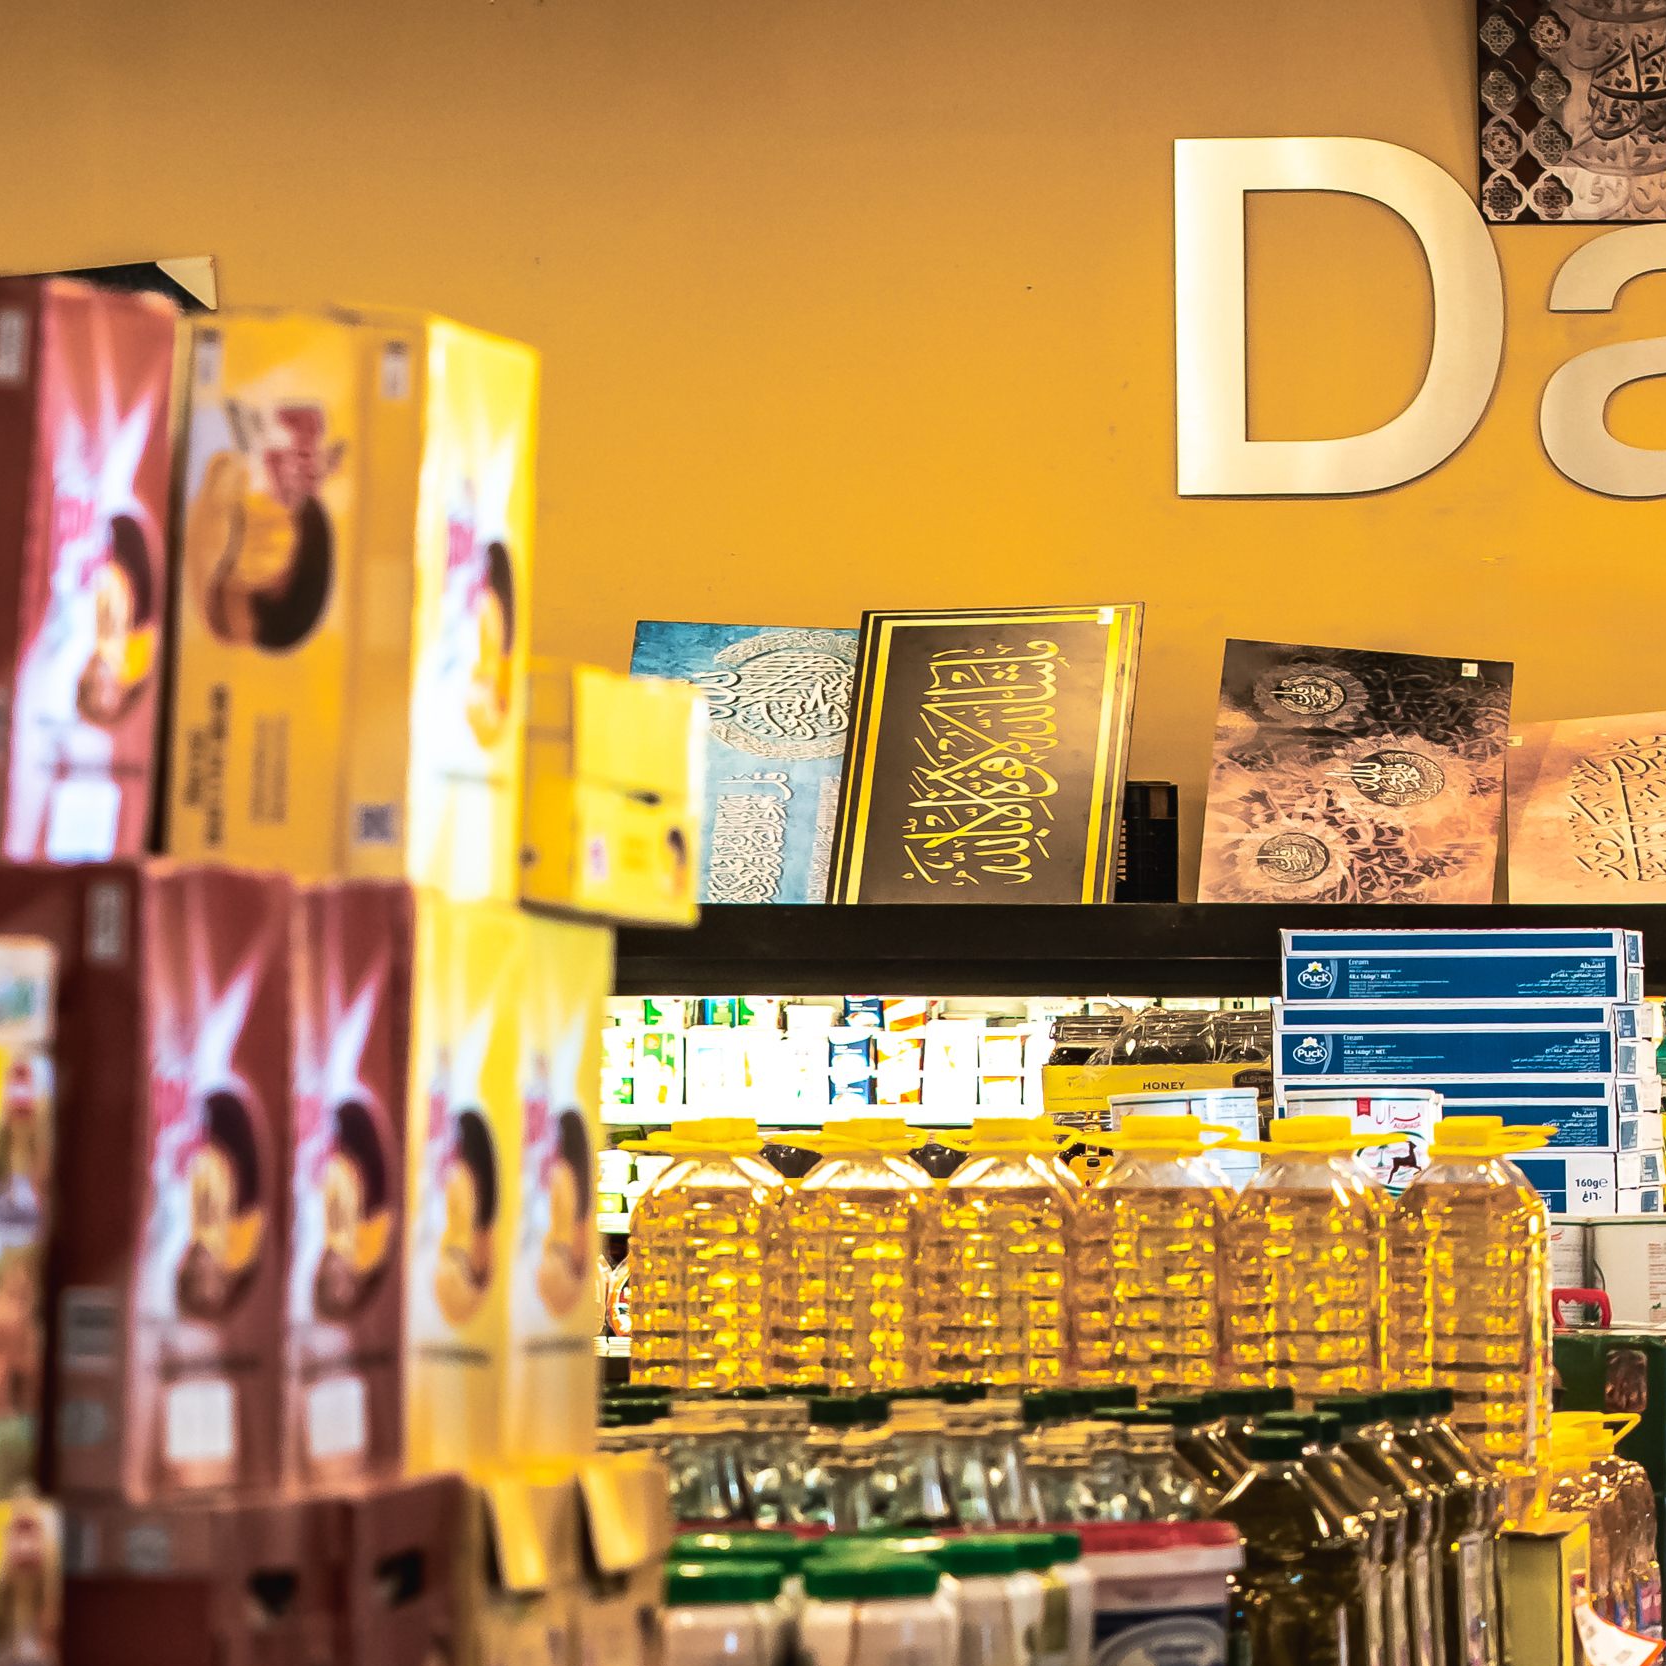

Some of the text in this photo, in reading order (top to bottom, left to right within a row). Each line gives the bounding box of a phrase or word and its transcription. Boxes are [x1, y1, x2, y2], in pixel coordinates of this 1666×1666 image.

[1302, 974, 1329, 984] Puck
[1298, 1049, 1324, 1059] Puck
[1142, 1082, 1185, 1091] HONEY
